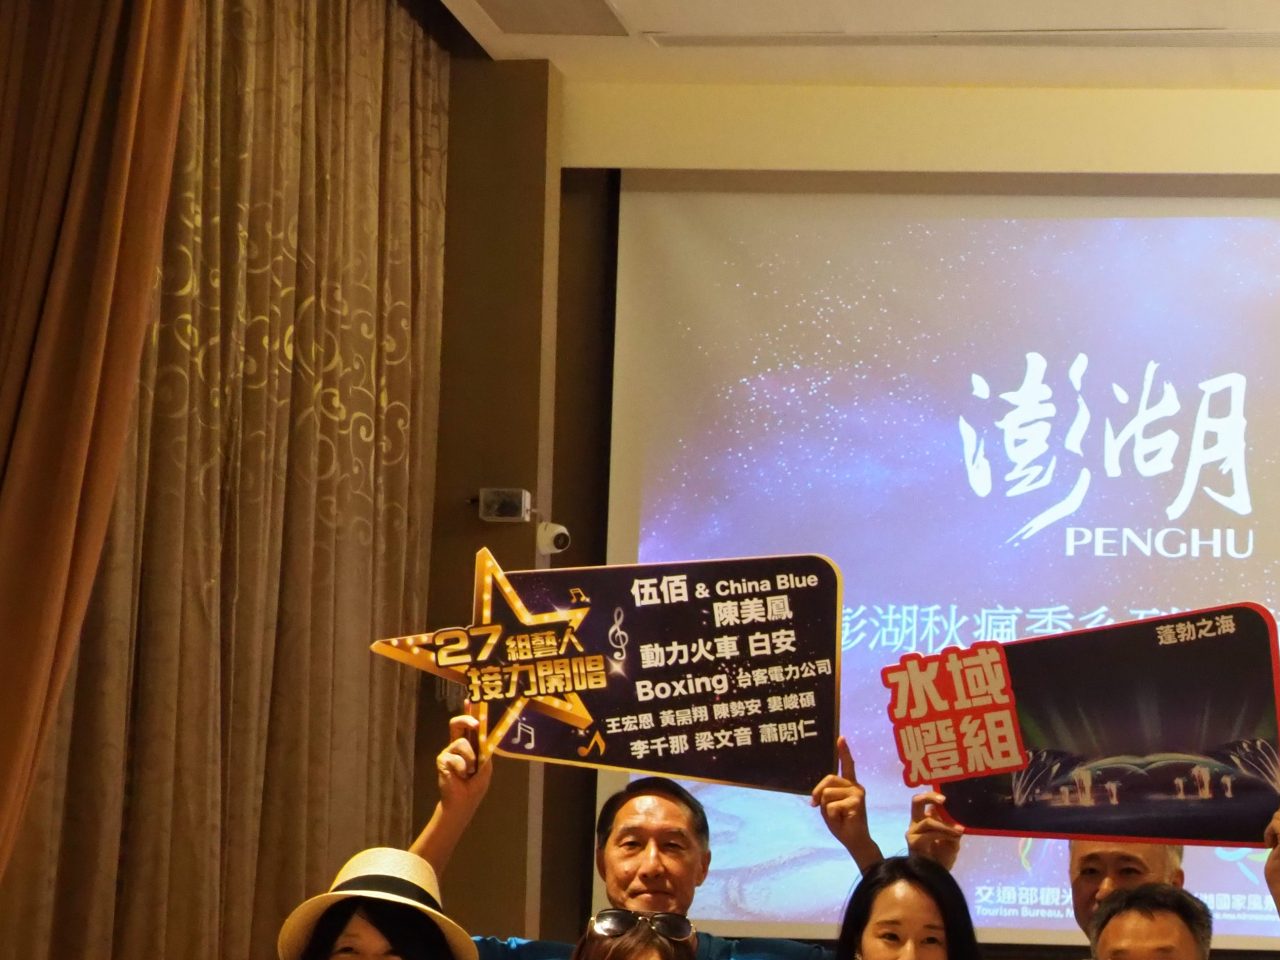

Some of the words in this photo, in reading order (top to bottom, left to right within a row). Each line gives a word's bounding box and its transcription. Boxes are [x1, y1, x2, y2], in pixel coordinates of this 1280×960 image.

[1065, 527, 1254, 559] PENGHU
[631, 575, 689, 607] 伍佰
[695, 583, 710, 598] &
[715, 578, 771, 596] China
[776, 574, 819, 590] Blue
[712, 595, 793, 627] 陳美鳳
[1156, 614, 1237, 647] 蓬勃之海
[639, 636, 740, 669] 動力火車
[748, 629, 797, 657] 白安
[467, 655, 608, 702] 接力開唱
[635, 672, 729, 702] Boxing
[736, 658, 832, 688] 台客電力公司
[886, 648, 1011, 719] 水域
[605, 712, 655, 735] 王宏恩
[630, 734, 689, 760] 李千那
[694, 726, 753, 751] 梁文音
[900, 709, 1024, 783] 燈組
